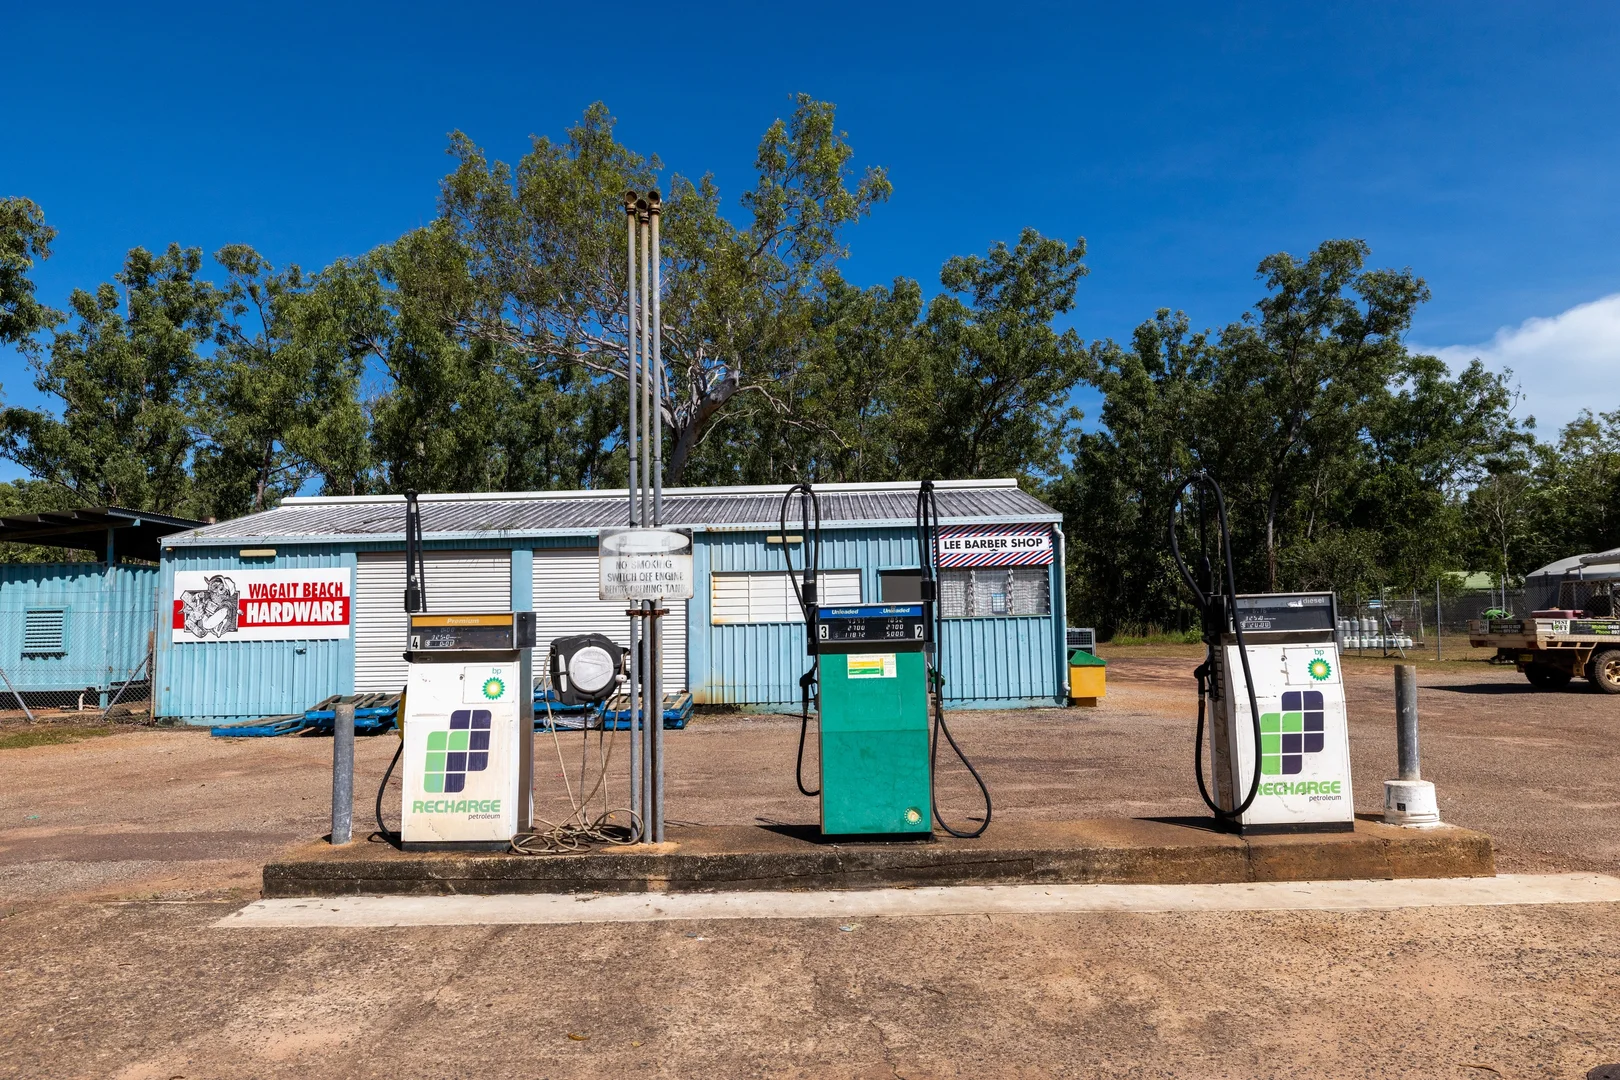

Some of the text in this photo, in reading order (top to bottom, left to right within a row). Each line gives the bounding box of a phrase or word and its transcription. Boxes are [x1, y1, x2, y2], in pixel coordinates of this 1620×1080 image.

[944, 538, 1043, 550] LEE BARBER SHOP
[616, 560, 628, 570] NO
[607, 572, 637, 583] SWITCH
[639, 572, 653, 582] OFF
[249, 582, 343, 598] WAGAIT BEACH
[246, 601, 343, 624] HARDWARE
[821, 626, 827, 638] 3
[916, 625, 922, 638] 2
[412, 637, 418, 649] 4
[1314, 649, 1325, 657] bp
[492, 667, 502, 675] bp
[412, 800, 501, 813] RECHARGE
